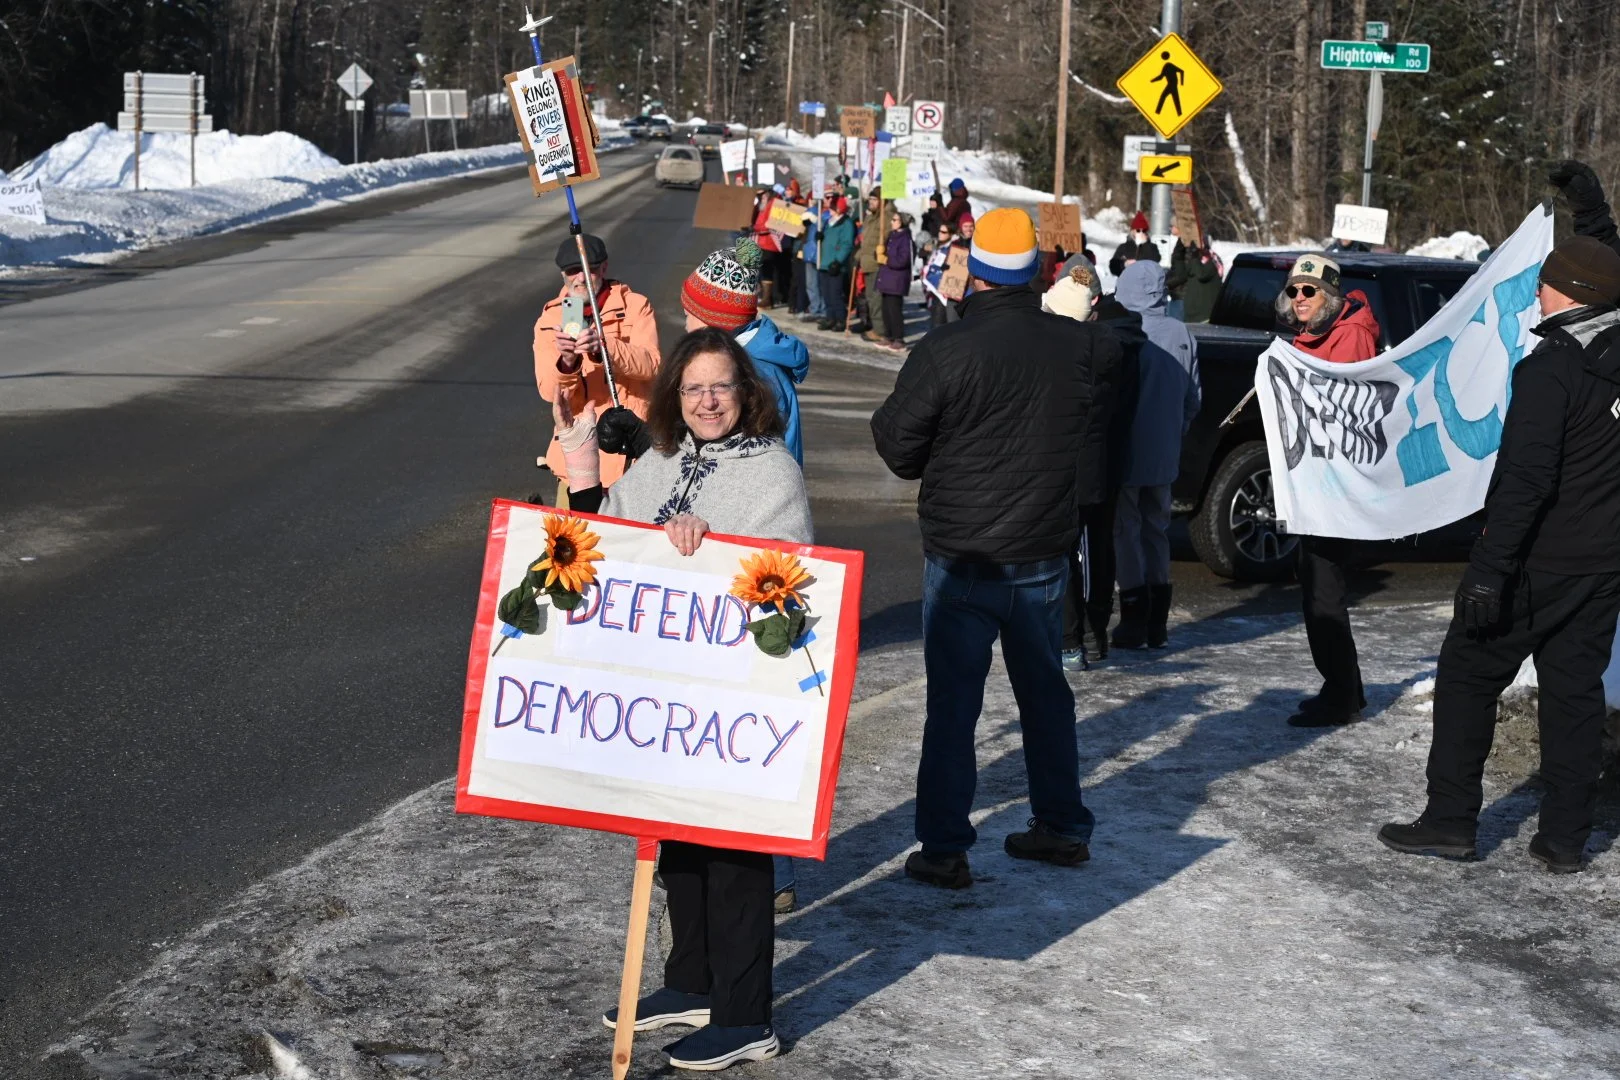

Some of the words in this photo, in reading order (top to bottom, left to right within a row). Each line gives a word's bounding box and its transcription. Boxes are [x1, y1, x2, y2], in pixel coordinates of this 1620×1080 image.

[1329, 46, 1395, 67] Hightower
[1408, 47, 1419, 57] Rd
[1405, 59, 1421, 68] 100
[524, 78, 556, 105] KING'S
[526, 98, 553, 117] BELONG
[536, 107, 561, 130] RIVERS
[888, 121, 907, 133] 30
[546, 134, 561, 147] NOT
[538, 144, 571, 167] GOVERNMENT
[918, 172, 930, 181] NO
[1043, 203, 1071, 224] SAVE
[1267, 355, 1400, 472] DEFUND
[566, 578, 752, 647] DEFEND
[494, 675, 803, 767] DEMOCRACY
